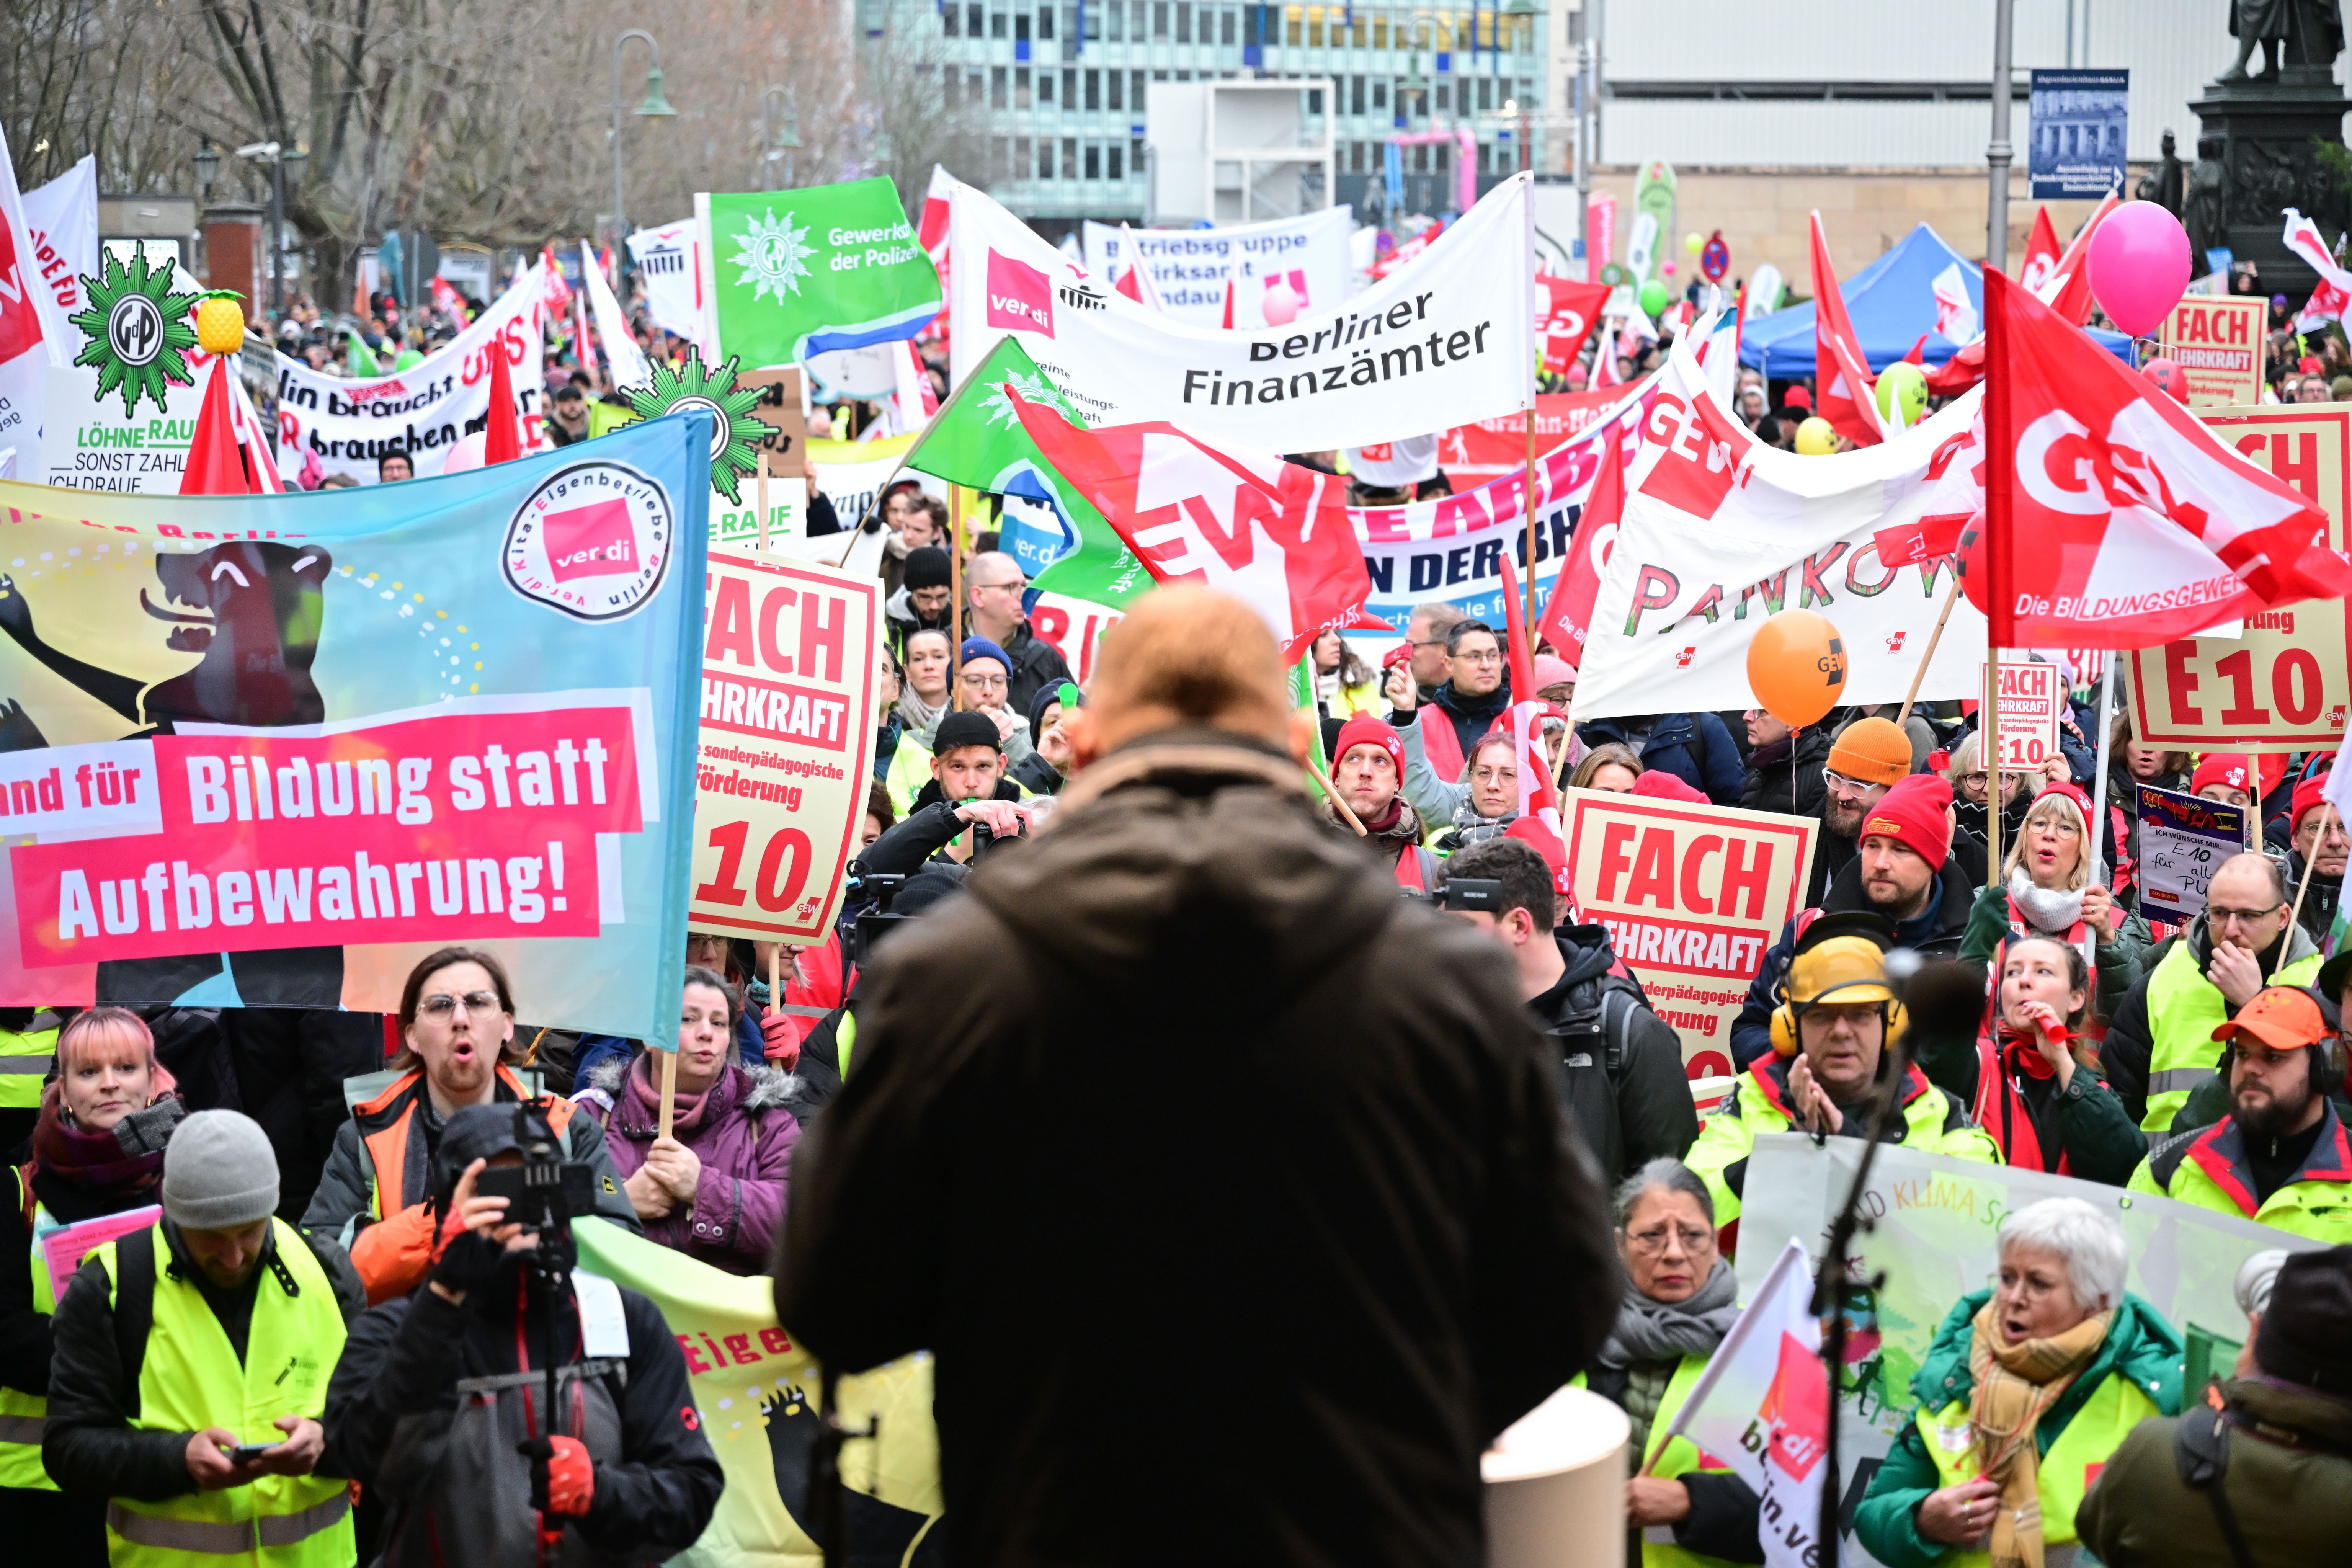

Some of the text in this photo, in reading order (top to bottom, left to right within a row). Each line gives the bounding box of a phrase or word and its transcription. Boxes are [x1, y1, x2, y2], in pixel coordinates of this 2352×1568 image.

[830, 251, 861, 271] der
[991, 294, 1049, 329] ver.di
[2176, 308, 2249, 345] FACH
[1183, 320, 1491, 406] Finanzämter
[2174, 348, 2250, 371] LEHRKRAFT
[328, 374, 454, 418] braucht
[78, 420, 197, 448] LÖHNE RAU
[309, 423, 457, 458] brauchen
[1645, 394, 1751, 490] GEW
[75, 452, 186, 472] SONST ZAHL
[49, 476, 77, 489] ICH
[556, 540, 629, 568] ver.di
[1410, 538, 1504, 593] DER
[2015, 593, 2050, 618] Die
[704, 573, 846, 684] ACH
[1558, 615, 1575, 635] Die
[1818, 652, 1844, 673] GEW
[2215, 648, 2324, 726] 10
[700, 678, 844, 742] HRKRAFT
[1998, 700, 2048, 713] EHRKRAFT
[2325, 712, 2347, 721] GEW
[2000, 724, 2037, 734] Förderung
[704, 744, 844, 781] sonderpädagogische
[2009, 738, 2044, 764] 10
[76, 761, 141, 809] für
[186, 756, 433, 826] Bildung
[449, 737, 608, 812] statt
[2226, 770, 2244, 782] GEW
[2155, 829, 2222, 849] ICH WÜNSCHE MIR:
[2172, 843, 2211, 862] E 10
[1596, 821, 1774, 920] FACH
[2151, 853, 2176, 870] für
[59, 841, 567, 940] Aufbewahrung!
[797, 903, 820, 915] GEW
[1589, 918, 1764, 973] EHRKRAFT
[1894, 1180, 1974, 1217] KLIMA
